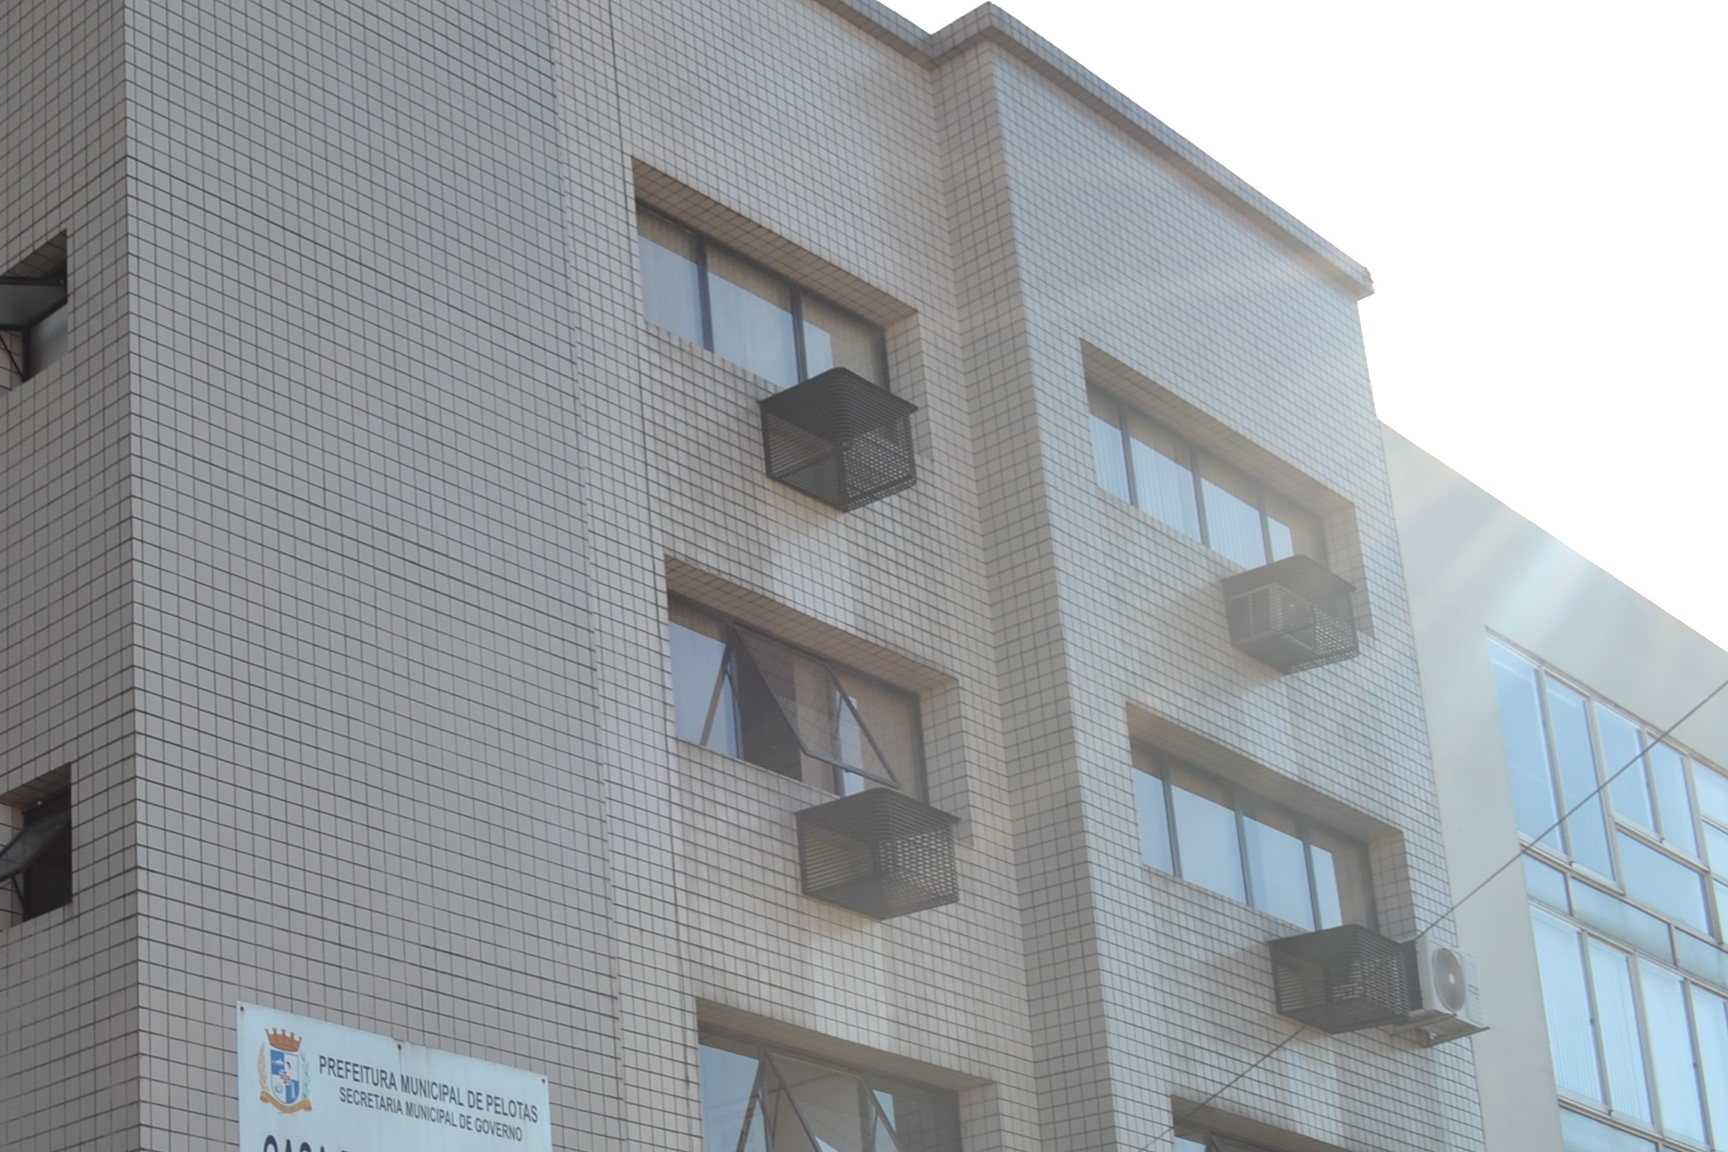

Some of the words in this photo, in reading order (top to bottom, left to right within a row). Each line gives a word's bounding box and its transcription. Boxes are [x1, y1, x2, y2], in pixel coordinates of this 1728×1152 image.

[319, 1055, 398, 1091] PREFEITURA
[400, 1074, 465, 1107] MUNICIPAL
[467, 1089, 484, 1111] DE
[486, 1094, 539, 1124] PELOTAS
[339, 1086, 403, 1115] SECRETARIA
[405, 1101, 457, 1128] MUNICIPAL
[459, 1113, 473, 1131] DE
[475, 1116, 523, 1142] GOVERNO
